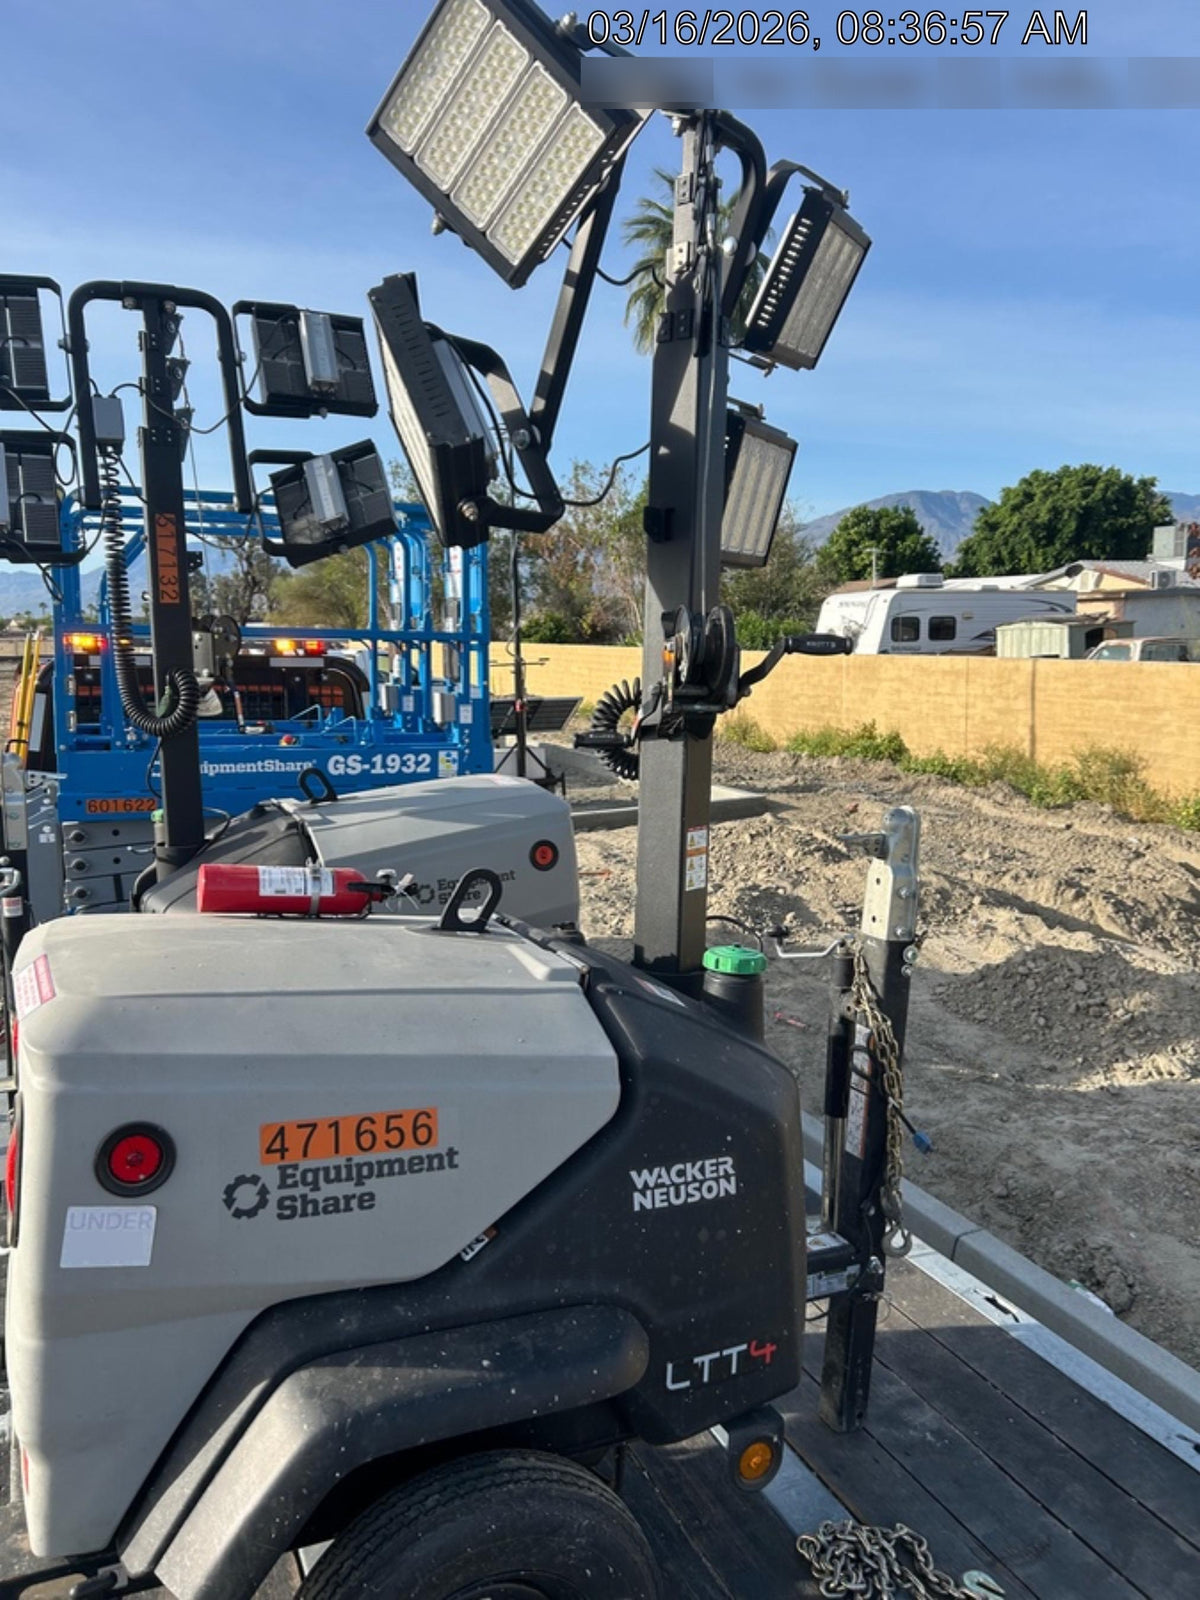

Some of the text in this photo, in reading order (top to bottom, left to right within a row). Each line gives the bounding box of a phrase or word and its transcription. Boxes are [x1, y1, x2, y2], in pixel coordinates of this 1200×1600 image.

[327, 753, 432, 775] GS-1932
[88, 798, 156, 813] 601622
[265, 1110, 433, 1161] 471656
[277, 1147, 459, 1192] Equipment
[629, 1156, 736, 1190] WACKER
[277, 1190, 376, 1221] Share
[633, 1176, 737, 1212] NEUSON
[69, 1209, 153, 1231] UNDER
[666, 1340, 777, 1391] LTT4
